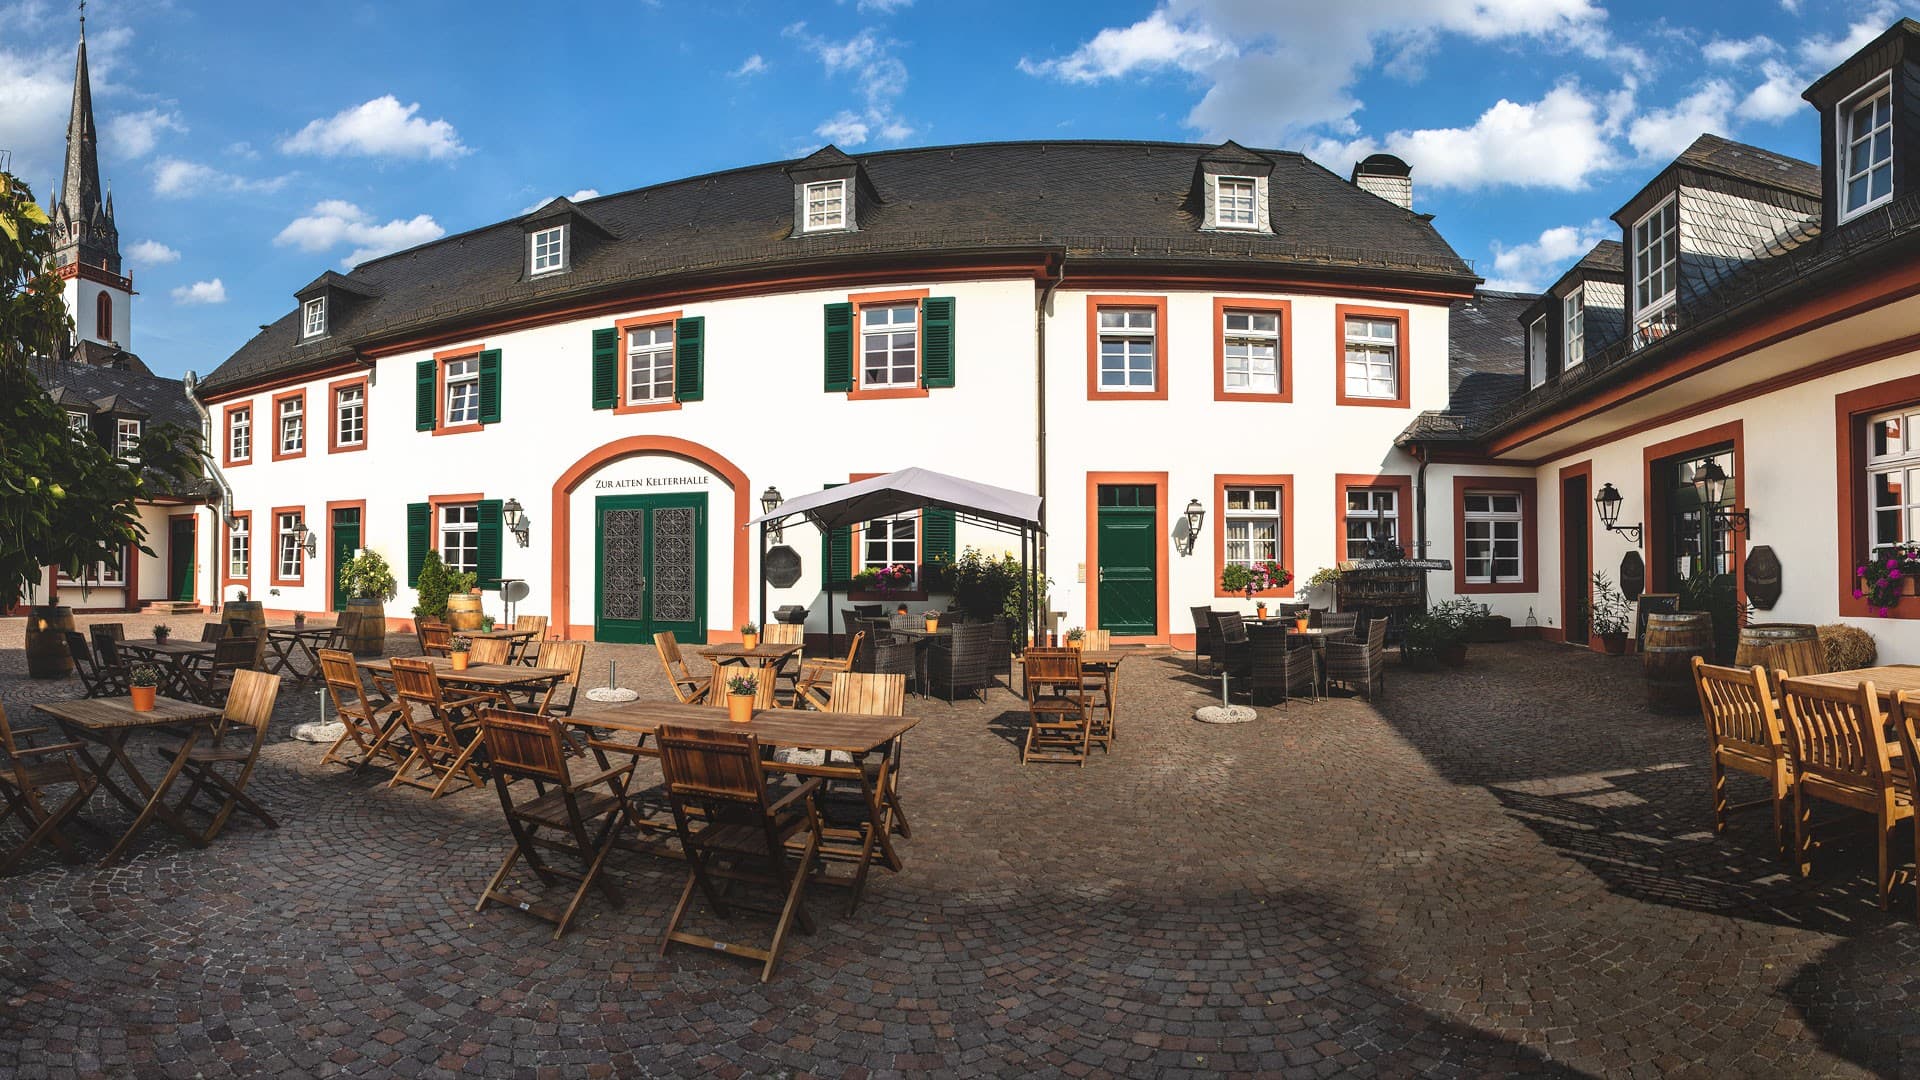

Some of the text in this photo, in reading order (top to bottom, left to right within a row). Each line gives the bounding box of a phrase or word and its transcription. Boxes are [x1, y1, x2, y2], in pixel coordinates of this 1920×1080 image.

[595, 476, 709, 489] ZUR ALTEN KELTERHALLE
